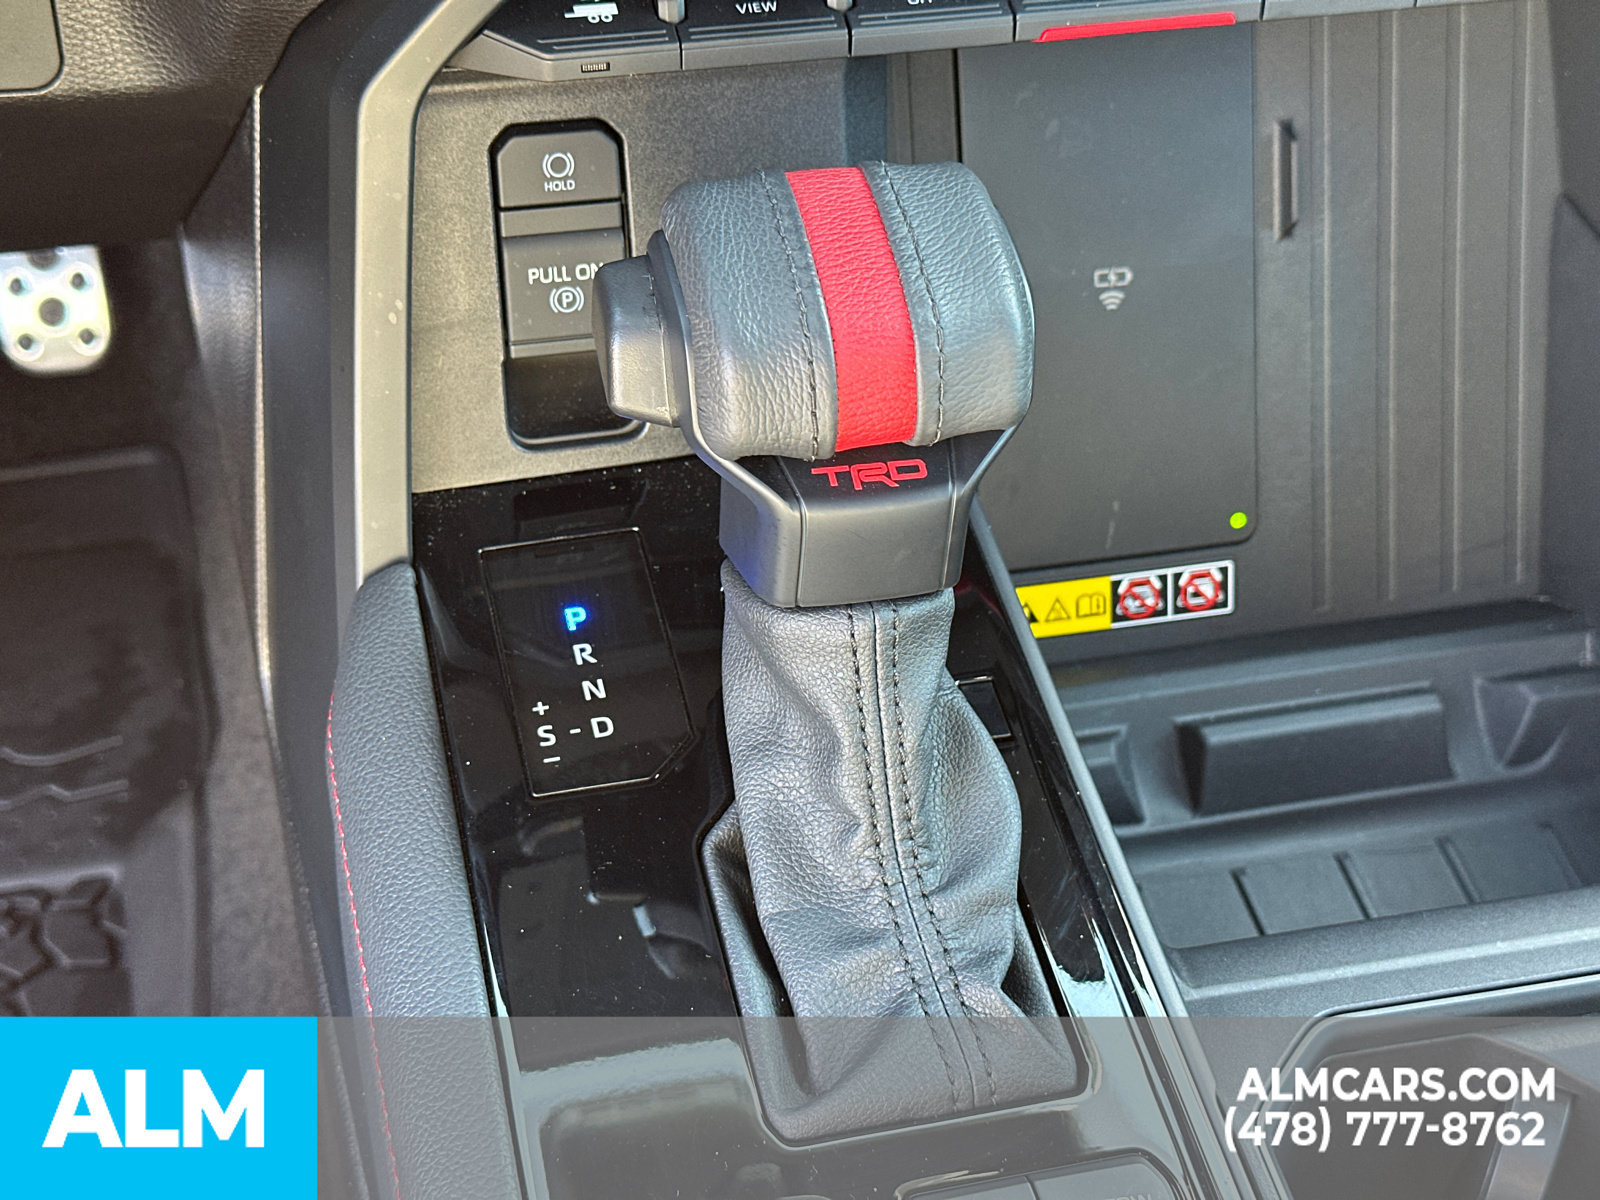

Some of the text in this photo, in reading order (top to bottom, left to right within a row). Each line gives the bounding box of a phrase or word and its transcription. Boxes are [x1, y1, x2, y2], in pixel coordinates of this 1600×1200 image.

[735, 1, 777, 15] VIEW
[544, 180, 575, 192] HOLD
[527, 265, 571, 285] PULL
[811, 458, 928, 491] TRD
[564, 606, 587, 631] P
[572, 643, 598, 666] R
[581, 678, 607, 701] N
[537, 724, 557, 747] S
[590, 716, 614, 739] D
